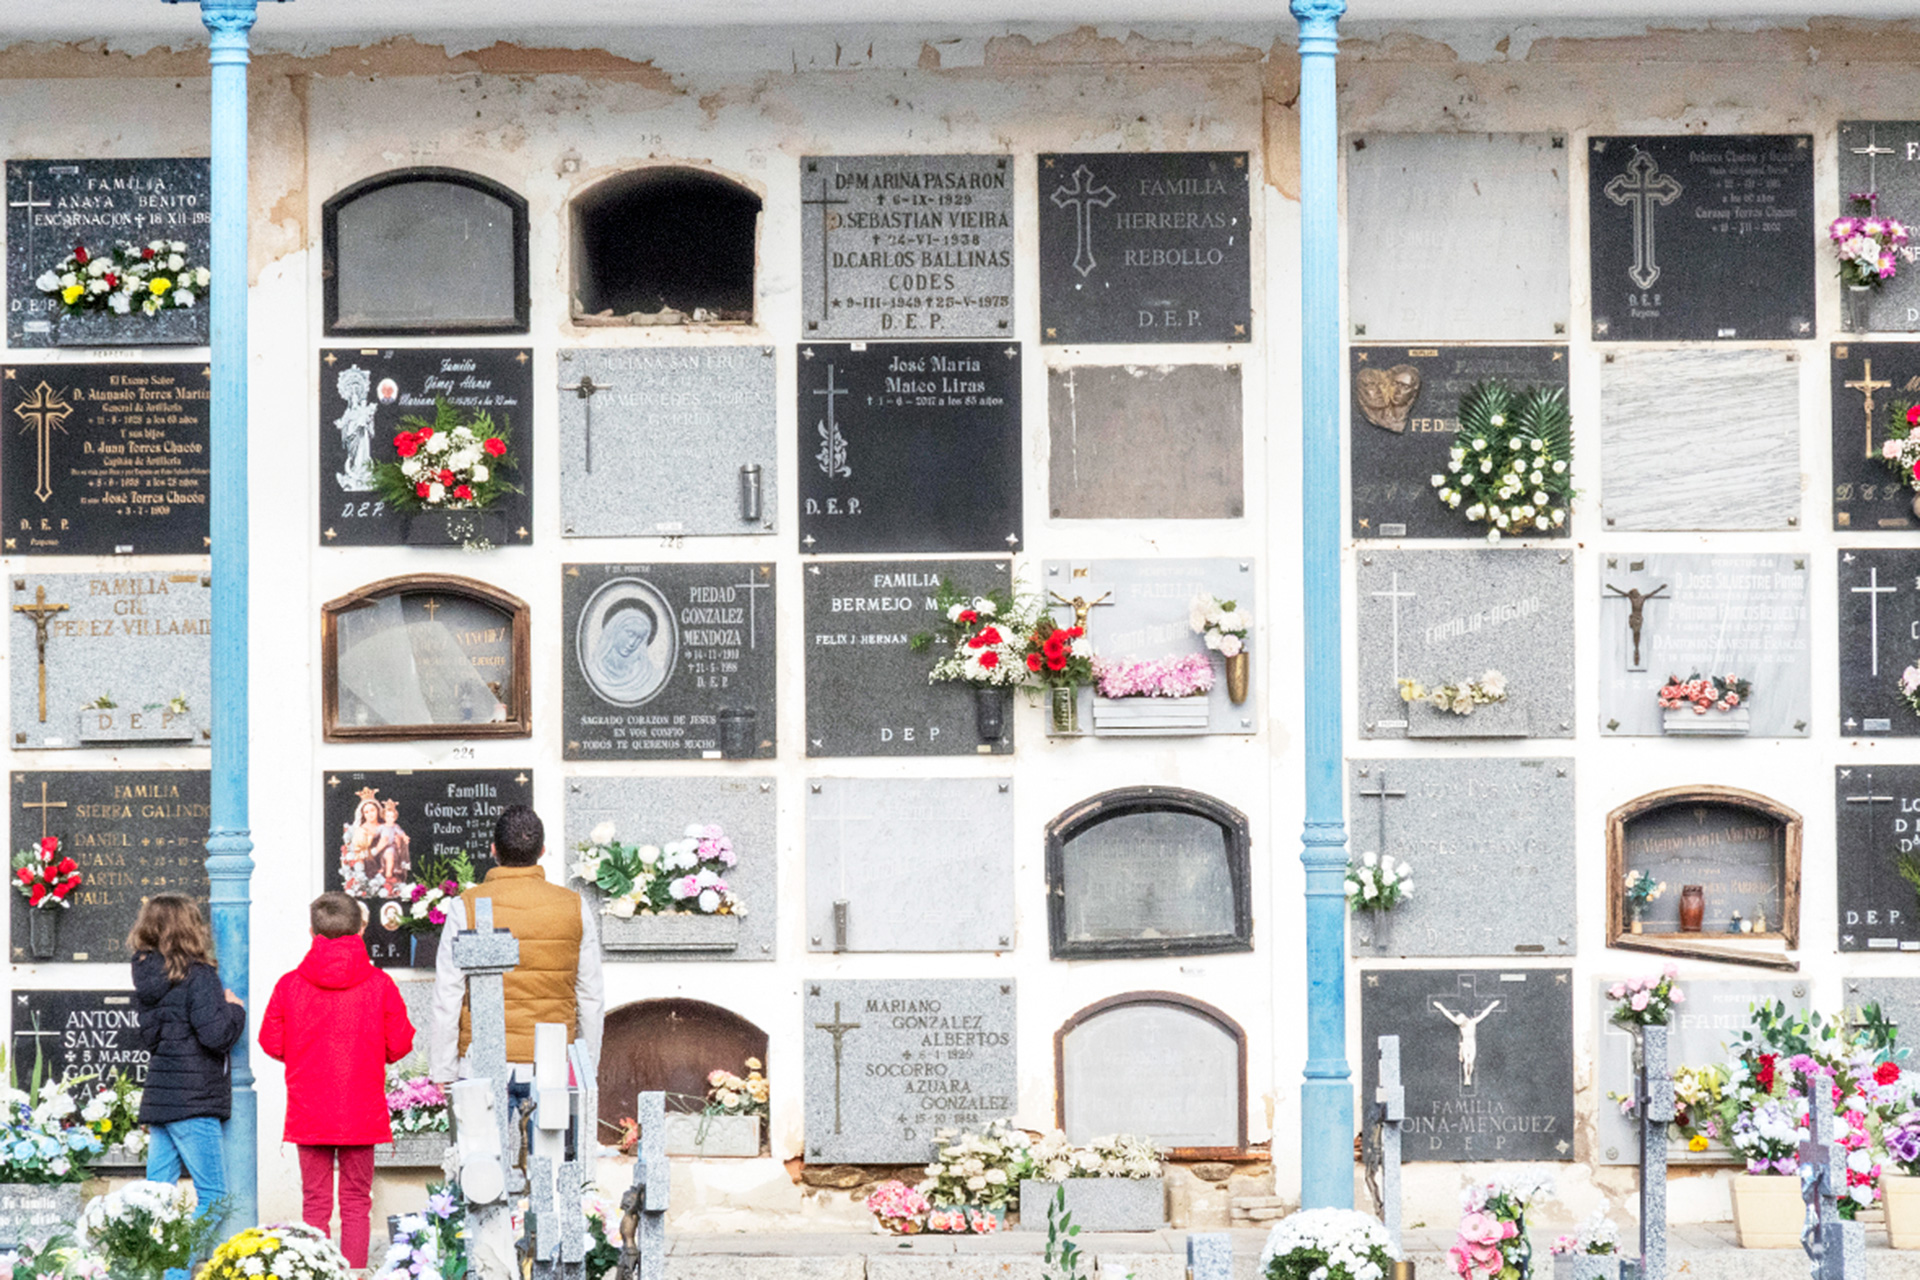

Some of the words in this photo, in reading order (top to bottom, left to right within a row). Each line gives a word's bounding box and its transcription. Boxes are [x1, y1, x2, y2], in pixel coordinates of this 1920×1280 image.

[88, 178, 166, 190] FAMILIA
[1139, 179, 1227, 195] FAMILIA
[58, 196, 114, 208] ANAYA
[139, 195, 197, 207] BENITO
[35, 214, 131, 225] ENCARNACION
[950, 211, 1009, 228] VIEIRA
[1116, 213, 1226, 229] HERRERAS
[922, 251, 1010, 268] BALLINAS
[1125, 249, 1224, 266] REBOLLO
[889, 274, 955, 291] CODES
[1139, 310, 1158, 327] D.
[1165, 310, 1182, 326] E.
[1188, 310, 1201, 326] P.
[441, 358, 476, 373] Familia
[888, 356, 925, 372] José
[885, 377, 936, 393] Mateo
[942, 377, 985, 393] Liras
[139, 388, 172, 399] Torres
[98, 441, 124, 454] Juan
[128, 441, 161, 453] Torres
[130, 491, 163, 504] Torres
[806, 498, 821, 515] D.
[827, 498, 843, 515] E.
[848, 498, 862, 514] P.
[90, 579, 169, 595] FAMILIA
[874, 574, 940, 588] FAMILIA
[689, 587, 736, 603] PIEDAD
[114, 601, 148, 615] GIL
[831, 598, 912, 612] BERMEJO
[681, 608, 744, 624] GONZALEZ
[683, 630, 742, 646] MENDOZA
[816, 635, 847, 645] FELIX
[861, 634, 907, 645] HERNAN
[581, 715, 623, 725] SAGRADO
[627, 715, 668, 725] CORAZON
[673, 715, 685, 725] DE
[689, 715, 716, 725] JESUS
[614, 728, 625, 737] EN
[651, 728, 684, 736] CONFIO
[881, 728, 893, 741] D
[904, 728, 914, 741] E
[930, 728, 940, 741] P
[582, 740, 611, 749] TODOS
[617, 740, 628, 749] TE
[632, 740, 680, 750] QUEREMOS
[684, 740, 715, 749] MUCHO
[115, 785, 179, 799] FAMILIA
[447, 783, 497, 799] Familia
[76, 805, 132, 818] SIERRA
[425, 803, 468, 818] Gómez
[433, 824, 463, 835] Pedro
[75, 834, 131, 846] DANIEL
[433, 843, 460, 855] Flora
[81, 872, 133, 885] ARTIN
[75, 892, 125, 905] PAULA
[865, 1000, 941, 1013] MARIANO
[893, 1016, 982, 1029] GONZALEZ
[64, 1030, 118, 1049] SANZ
[921, 1032, 1009, 1046] ALBERTOS
[83, 1051, 92, 1062] 5
[100, 1051, 150, 1063] MARZO
[865, 1064, 948, 1077] SOCORRO
[904, 1080, 971, 1093] AZUARA
[921, 1096, 1009, 1110] GONZALEZ
[1432, 1101, 1505, 1114] FAMILIA
